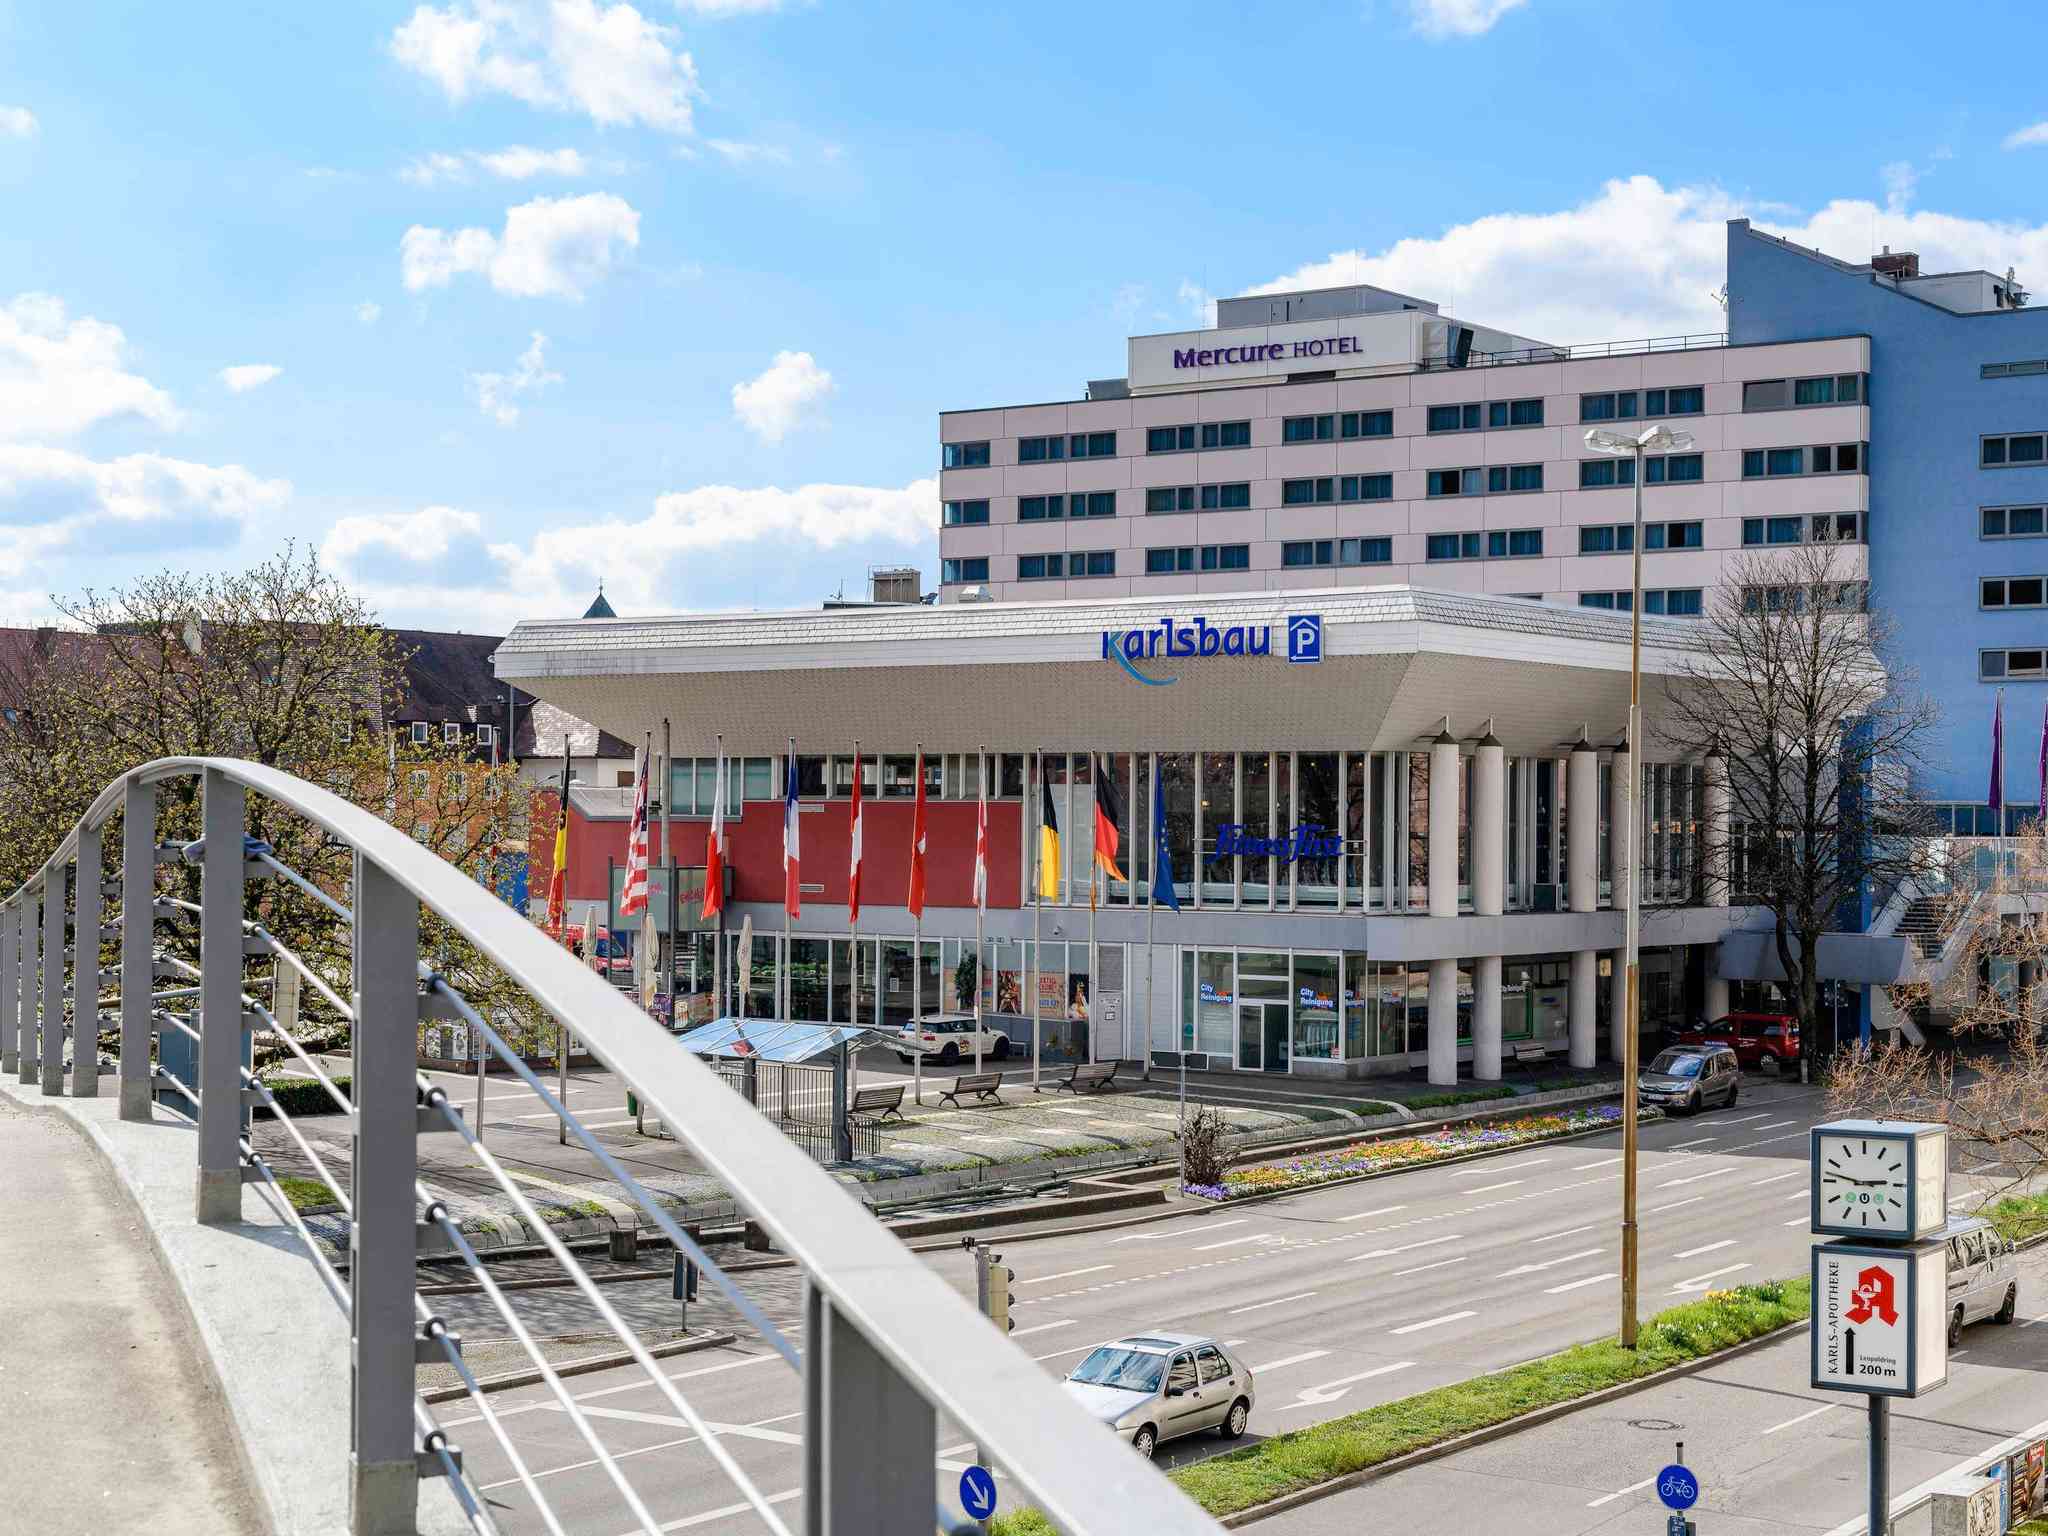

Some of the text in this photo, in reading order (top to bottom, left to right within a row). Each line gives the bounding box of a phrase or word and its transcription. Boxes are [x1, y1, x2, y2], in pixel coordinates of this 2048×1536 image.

[1173, 336, 1364, 369] Mercure HOTEL
[1297, 628, 1315, 654] P
[1102, 616, 1271, 686] Karlsbau
[1200, 983, 1215, 993] City
[1300, 987, 1314, 997] City
[1200, 993, 1232, 1003] Reinigung
[1300, 997, 1333, 1008] Reinigung
[1828, 1261, 1840, 1375] KARLS-APOTHEKE
[1860, 1364, 1896, 1377] 200 m
